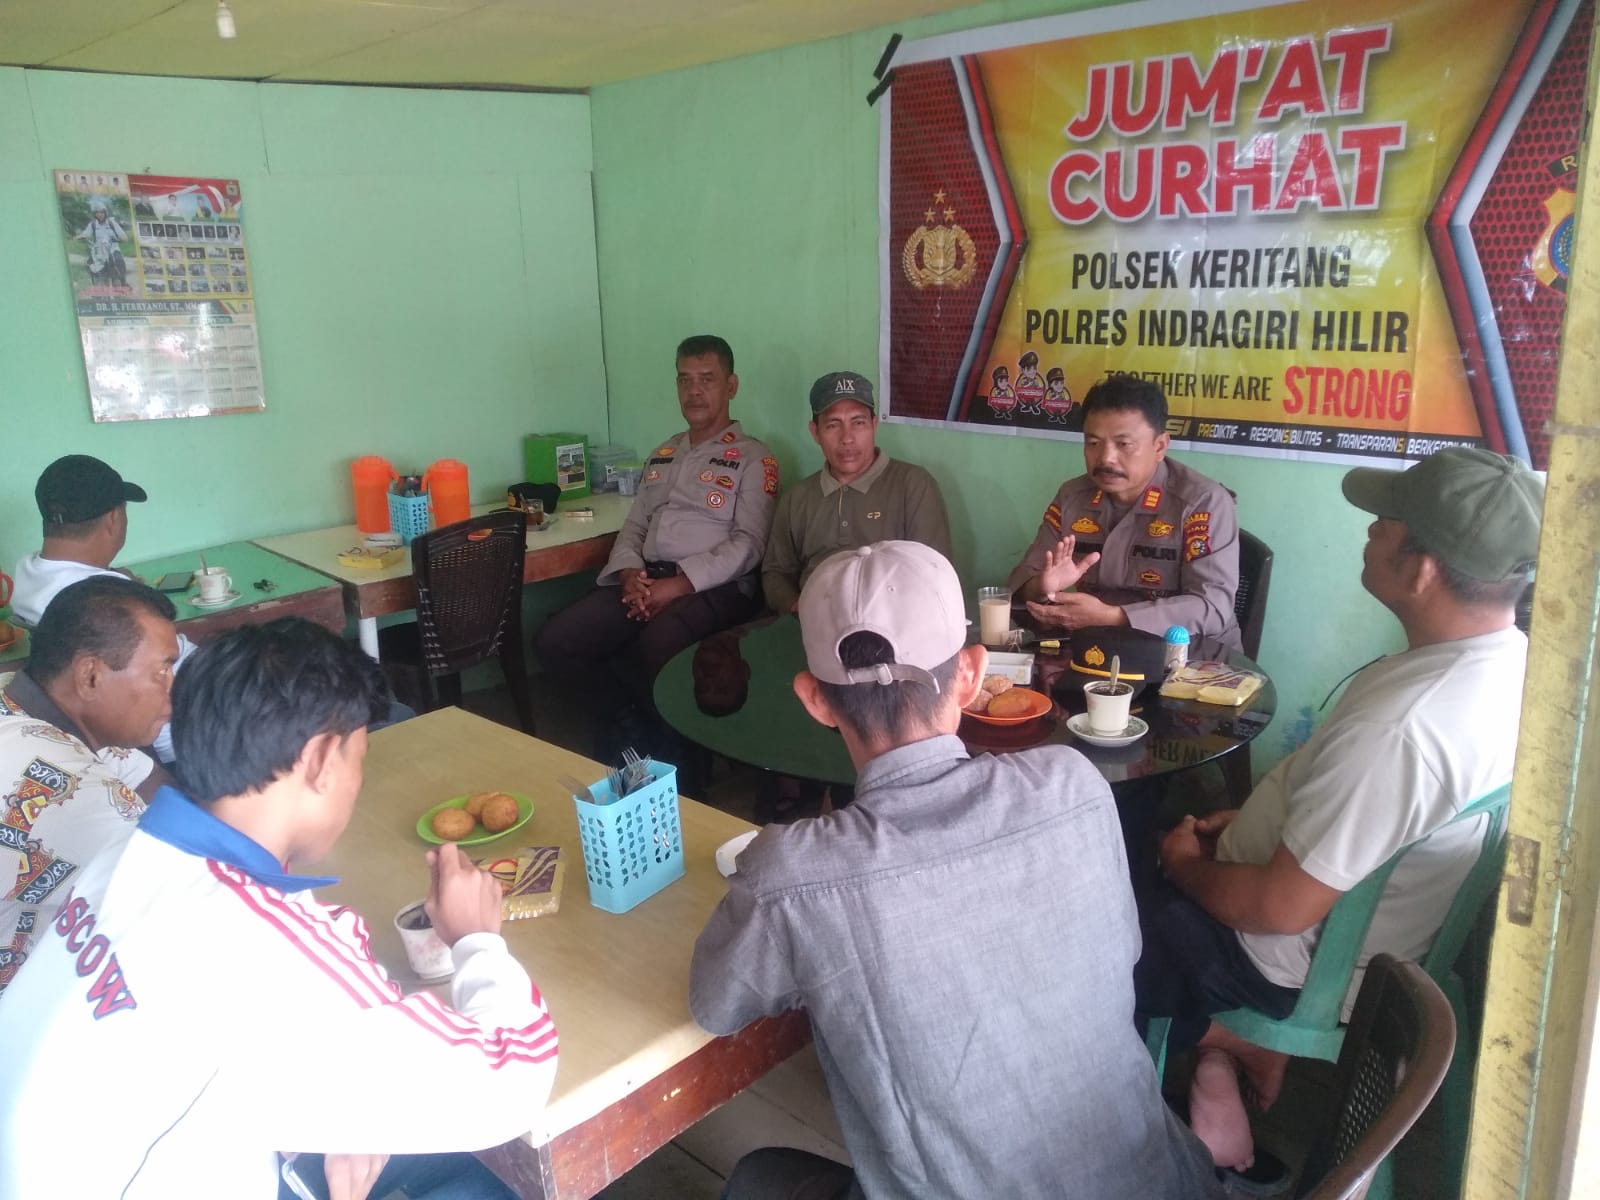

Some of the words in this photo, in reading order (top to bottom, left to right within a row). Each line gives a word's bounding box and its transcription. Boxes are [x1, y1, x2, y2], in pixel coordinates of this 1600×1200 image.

[1064, 25, 1390, 139] JUM'AT
[1050, 123, 1404, 222] CURHAT
[1072, 249, 1181, 290] POLSEK
[1189, 245, 1352, 289] KERITANG
[1025, 308, 1127, 345] POLRES
[1137, 308, 1299, 350] INDRAGIRI
[1311, 310, 1410, 353] HILIR
[1201, 374, 1228, 398] WE
[1232, 375, 1273, 401] ARE
[1282, 365, 1412, 421] STRONG
[709, 457, 740, 470] POLRI
[1132, 544, 1177, 561] POLRI
